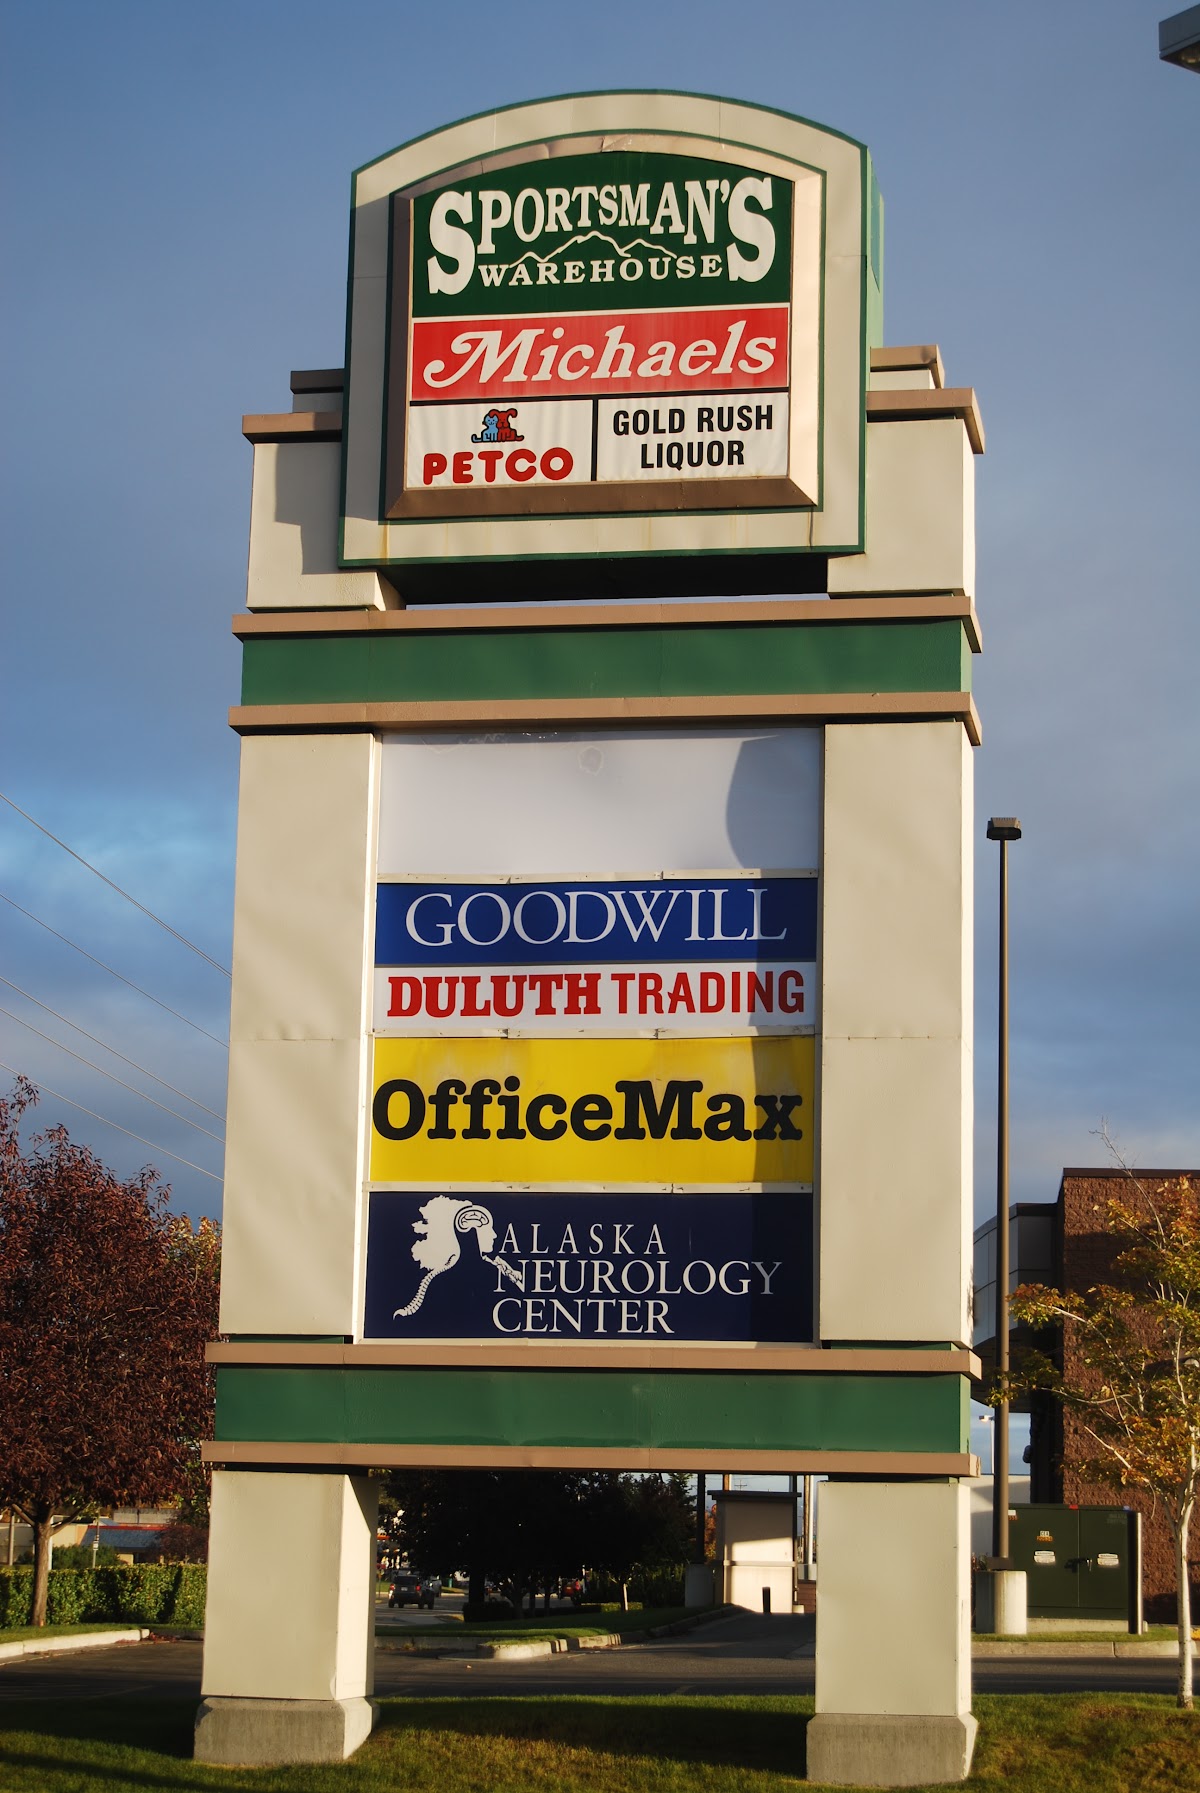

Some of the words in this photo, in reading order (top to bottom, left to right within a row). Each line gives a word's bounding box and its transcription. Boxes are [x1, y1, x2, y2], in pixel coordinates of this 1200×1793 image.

[427, 176, 776, 295] SPORTSMAN'S
[478, 255, 723, 287] WAREHOUSE
[423, 320, 776, 388] Michaels
[613, 410, 685, 436] GOLD
[698, 405, 773, 432] RUSH
[423, 447, 574, 485] PETCO
[641, 440, 745, 472] LIQUOR
[405, 888, 787, 947] GOODWILL
[387, 973, 602, 1018] DULUTH
[610, 969, 804, 1015] TRADING
[372, 1075, 804, 1141] OfficeMax
[499, 1223, 667, 1255] ALASKA
[493, 1259, 783, 1295] NEUROLOGY
[492, 1297, 675, 1334] CENTER
